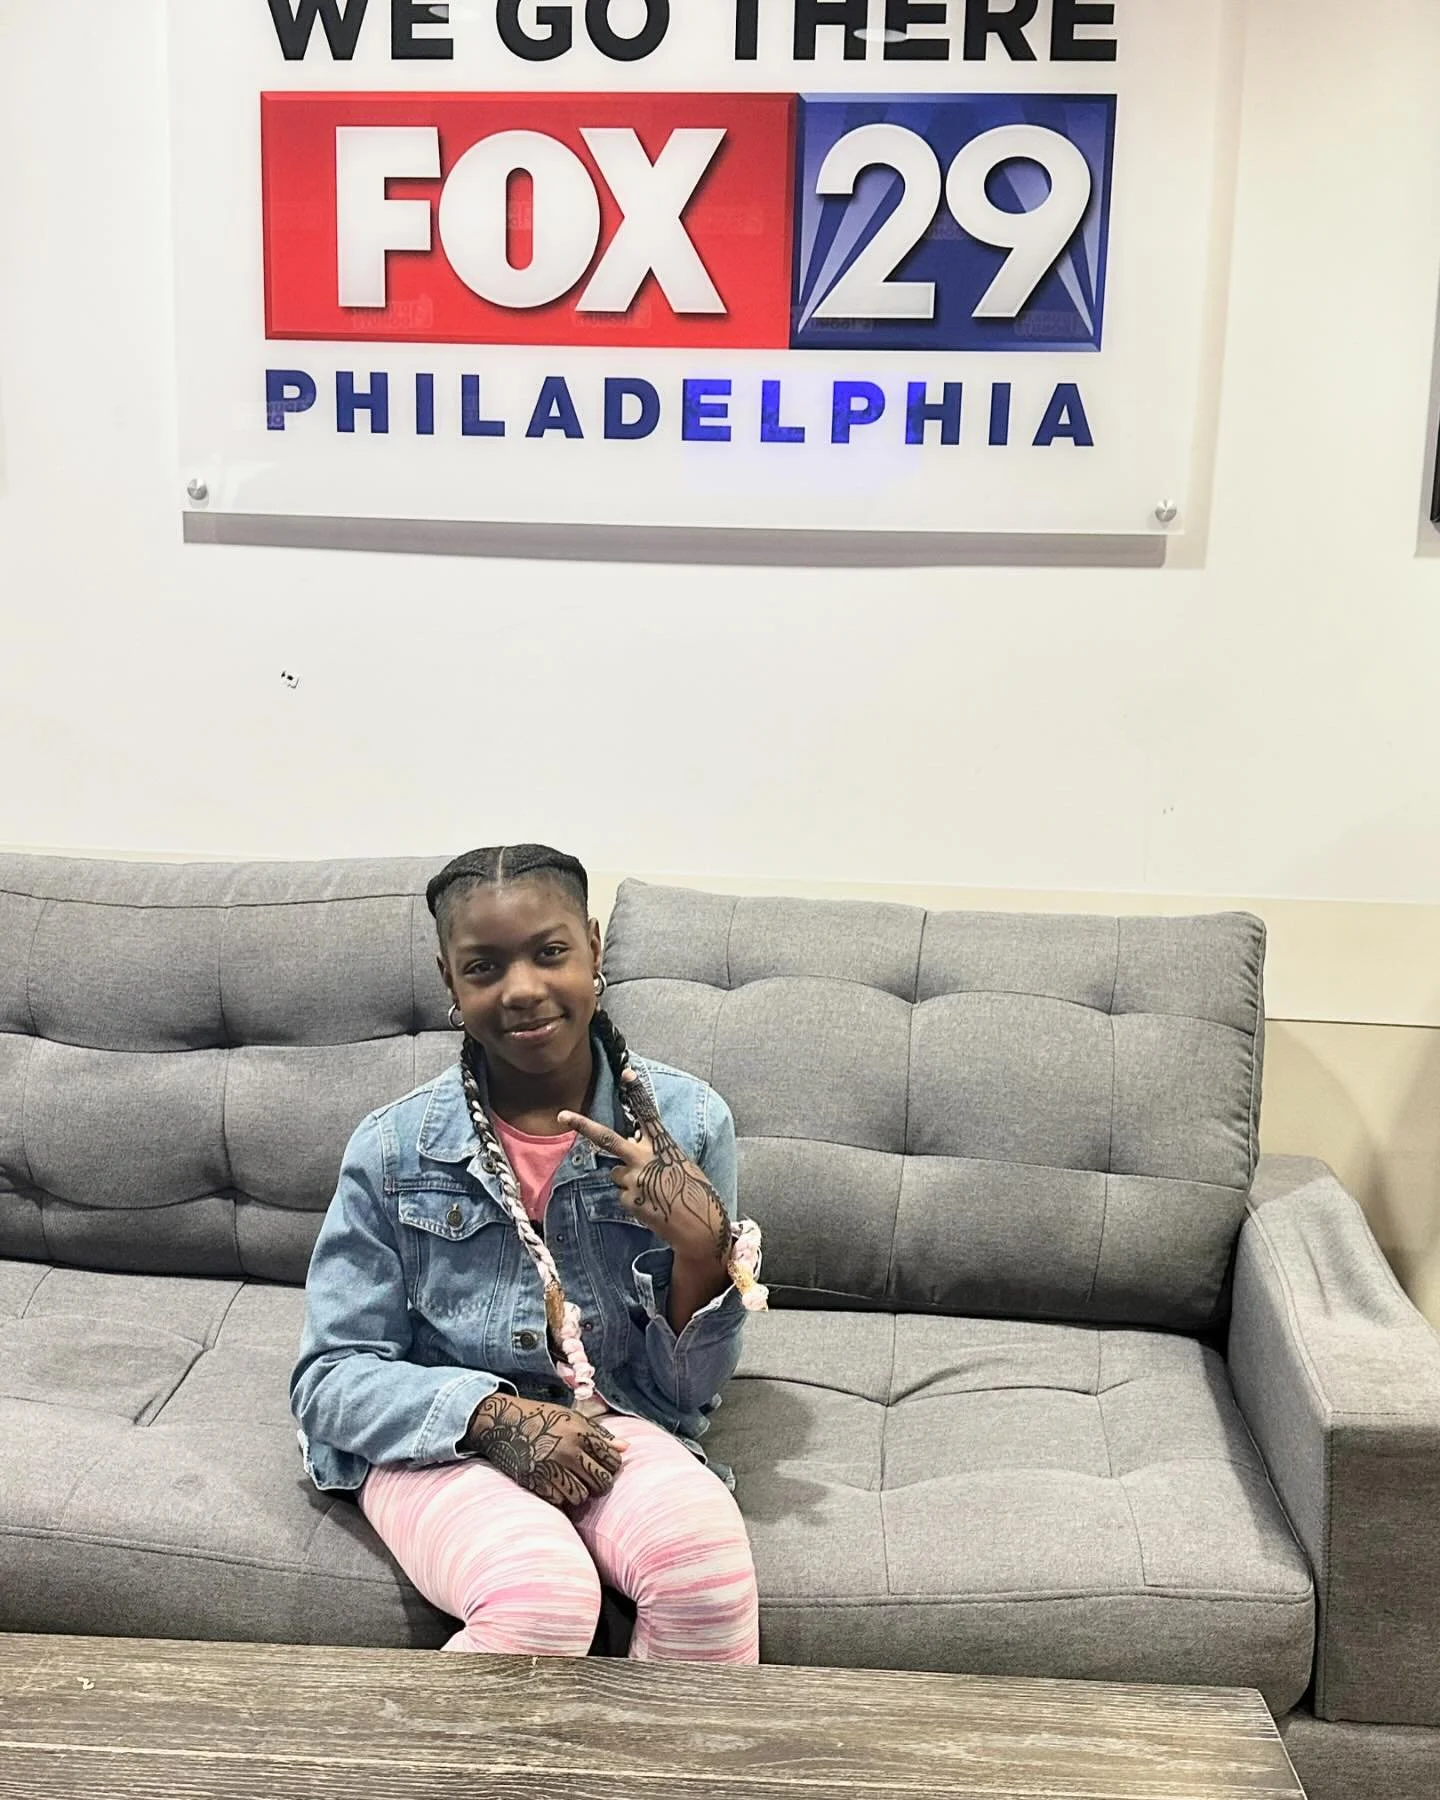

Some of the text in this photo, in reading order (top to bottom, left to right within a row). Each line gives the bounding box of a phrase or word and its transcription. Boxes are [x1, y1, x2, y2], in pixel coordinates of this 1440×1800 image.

[268, 0, 454, 61] WE
[495, 0, 670, 62] GO
[335, 123, 1092, 319] FOX 29
[265, 369, 1095, 447] PHILADELPHIA
